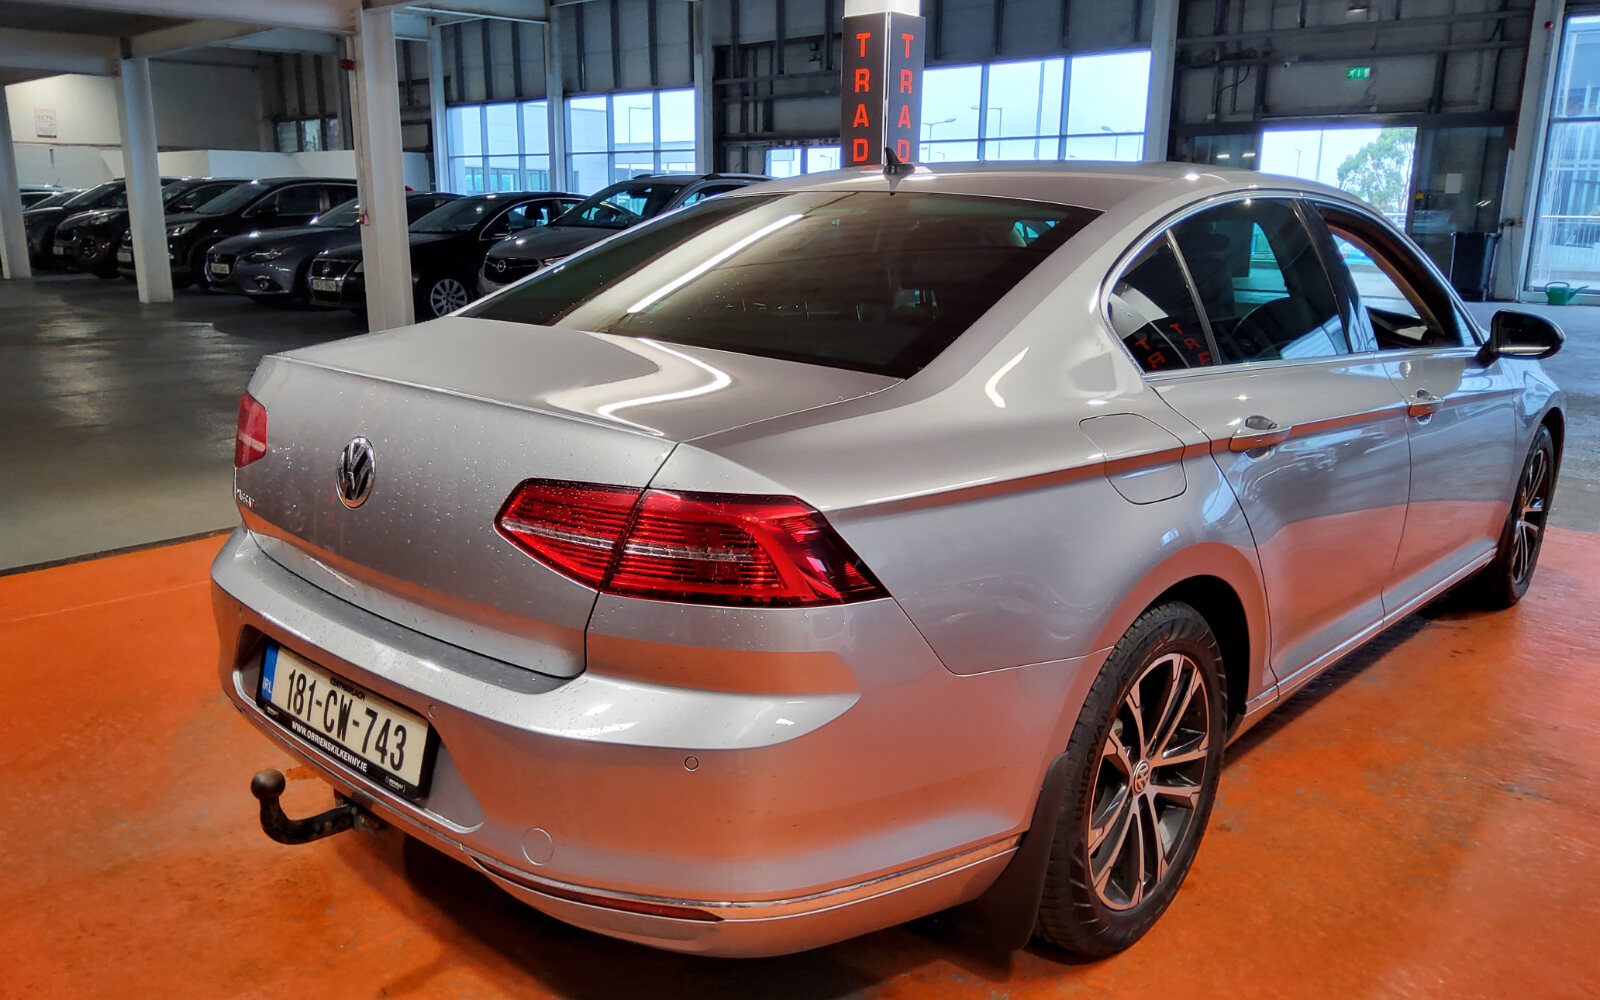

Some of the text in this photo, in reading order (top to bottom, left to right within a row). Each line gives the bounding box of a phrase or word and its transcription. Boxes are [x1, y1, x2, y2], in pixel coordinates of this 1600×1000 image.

[262, 676, 272, 695] IRL
[286, 669, 407, 771] 181-CW-743
[291, 720, 368, 773] WWW.OBRIENSKILKENNY.IE
